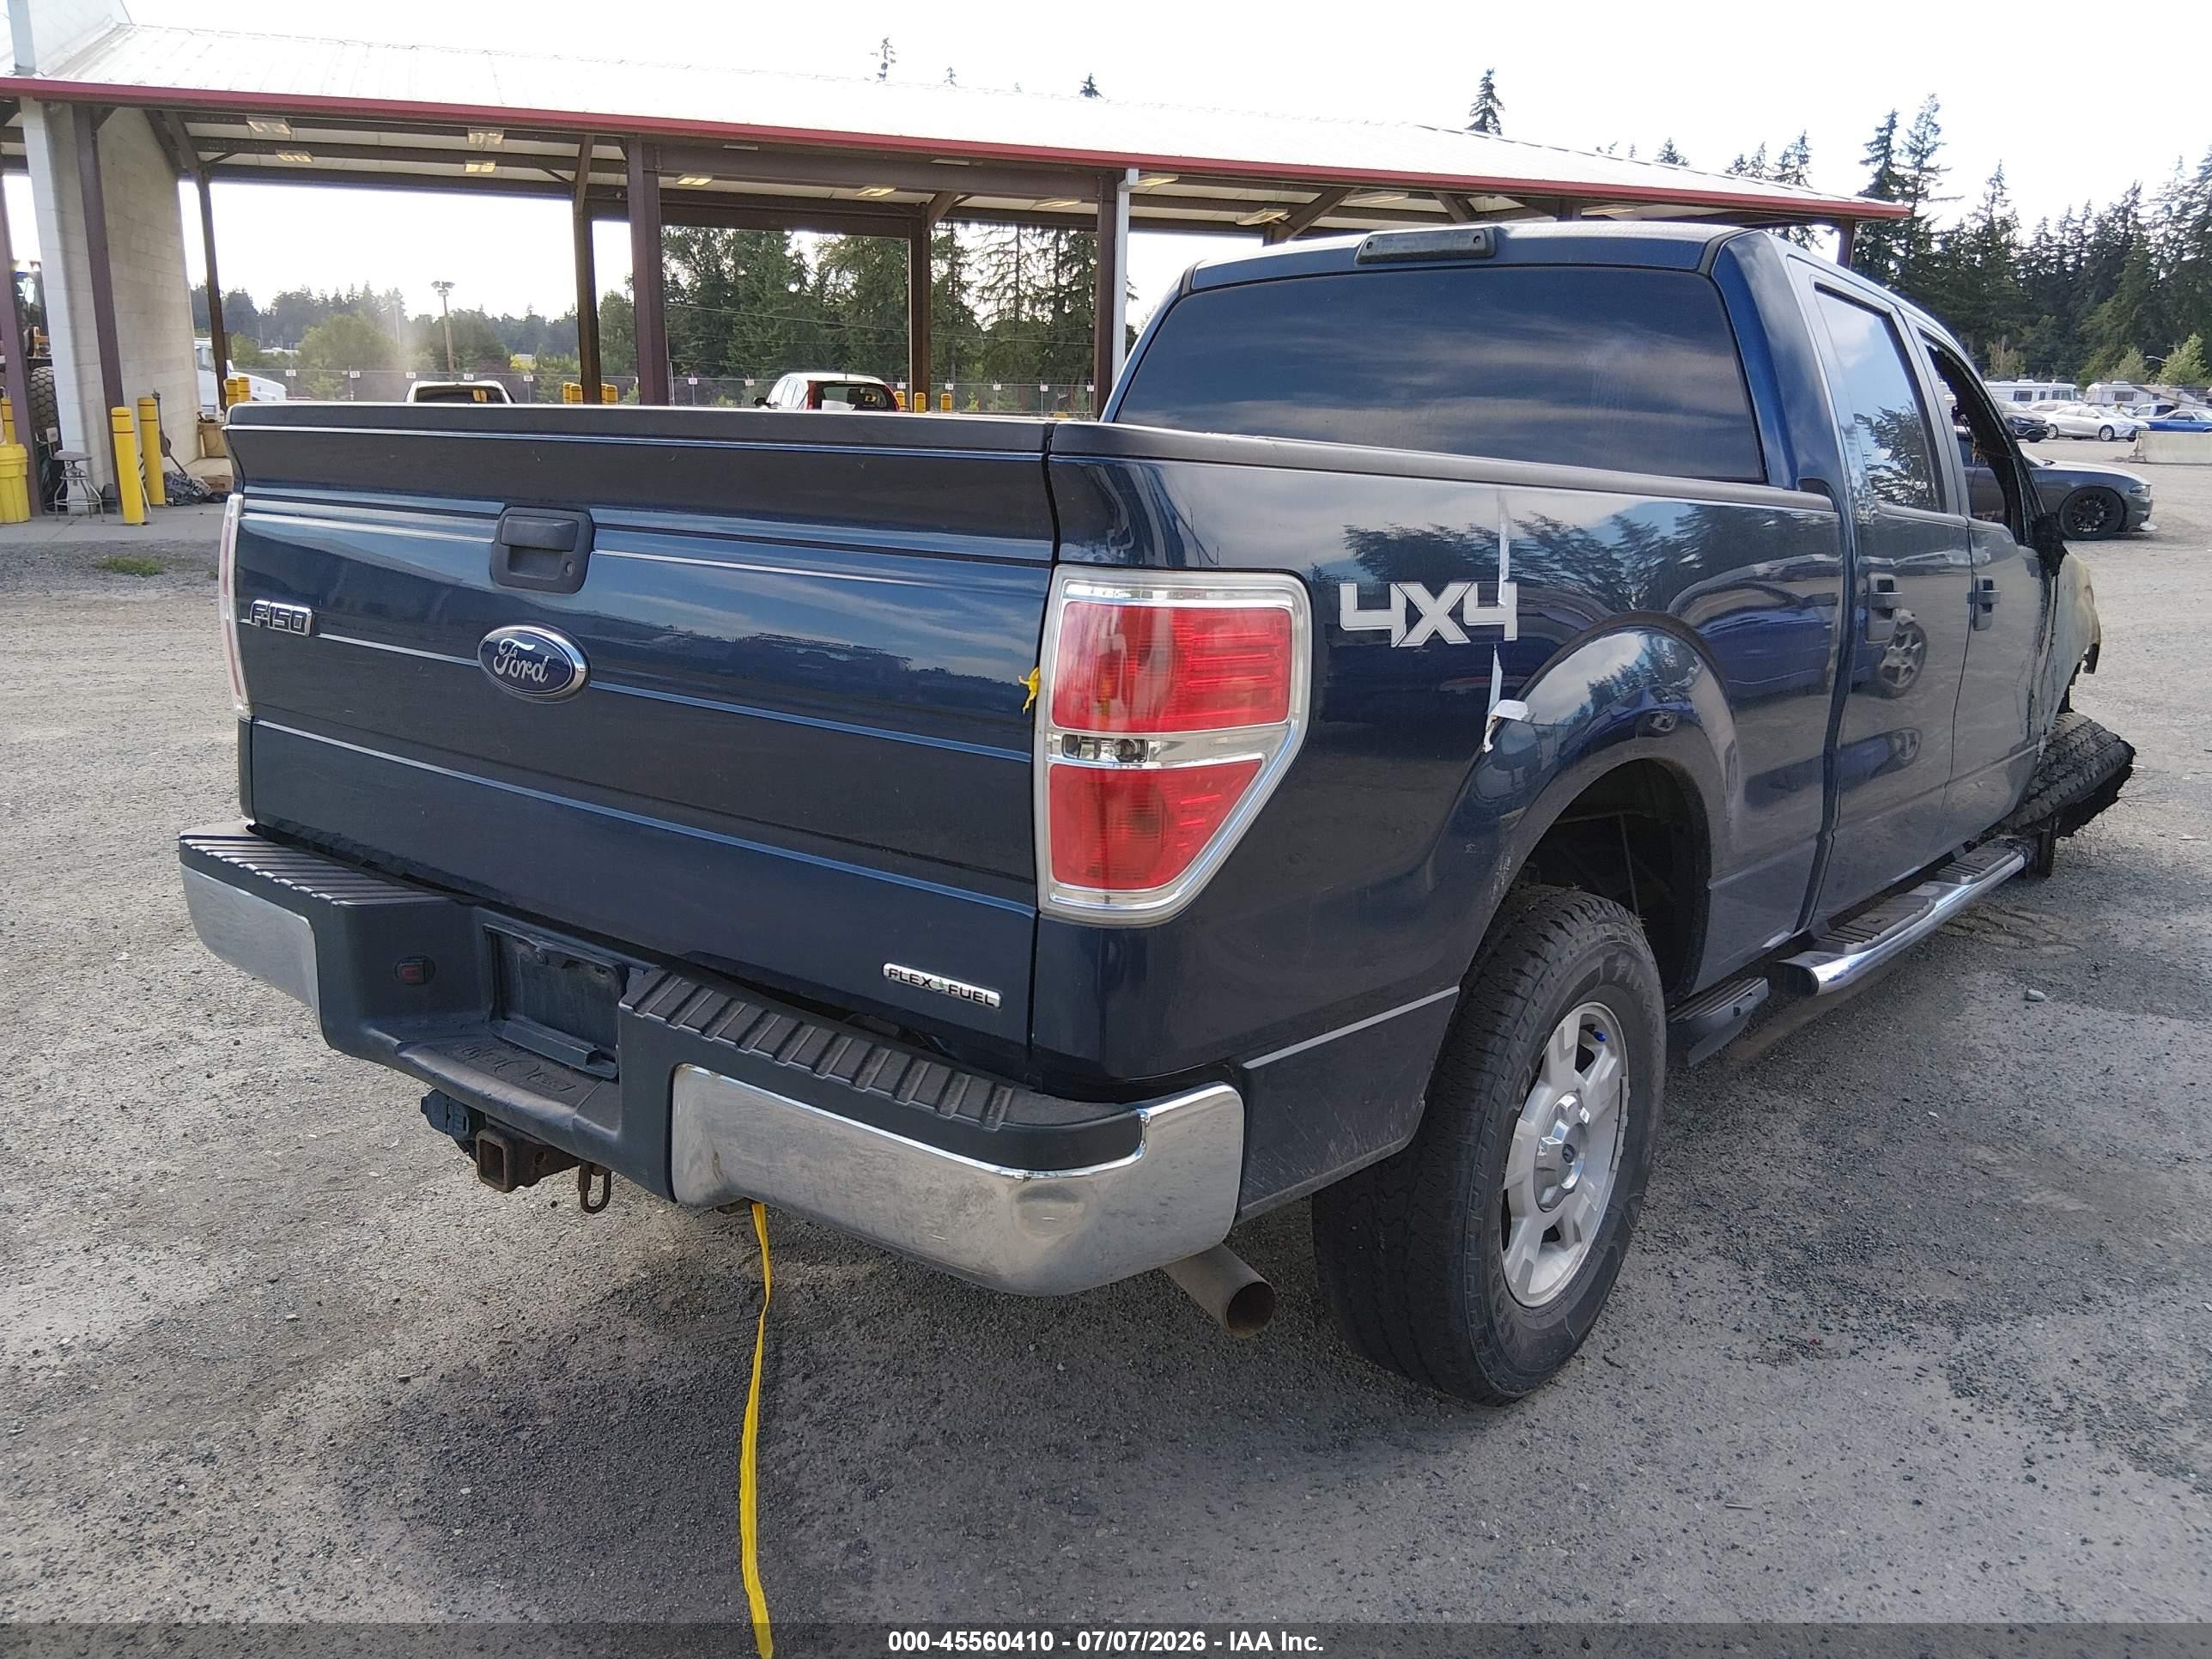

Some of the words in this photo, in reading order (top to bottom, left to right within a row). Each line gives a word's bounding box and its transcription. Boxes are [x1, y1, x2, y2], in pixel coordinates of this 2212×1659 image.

[494, 638, 550, 684] Ford
[888, 968, 933, 989] FLEX
[948, 984, 996, 1007] FUEL
